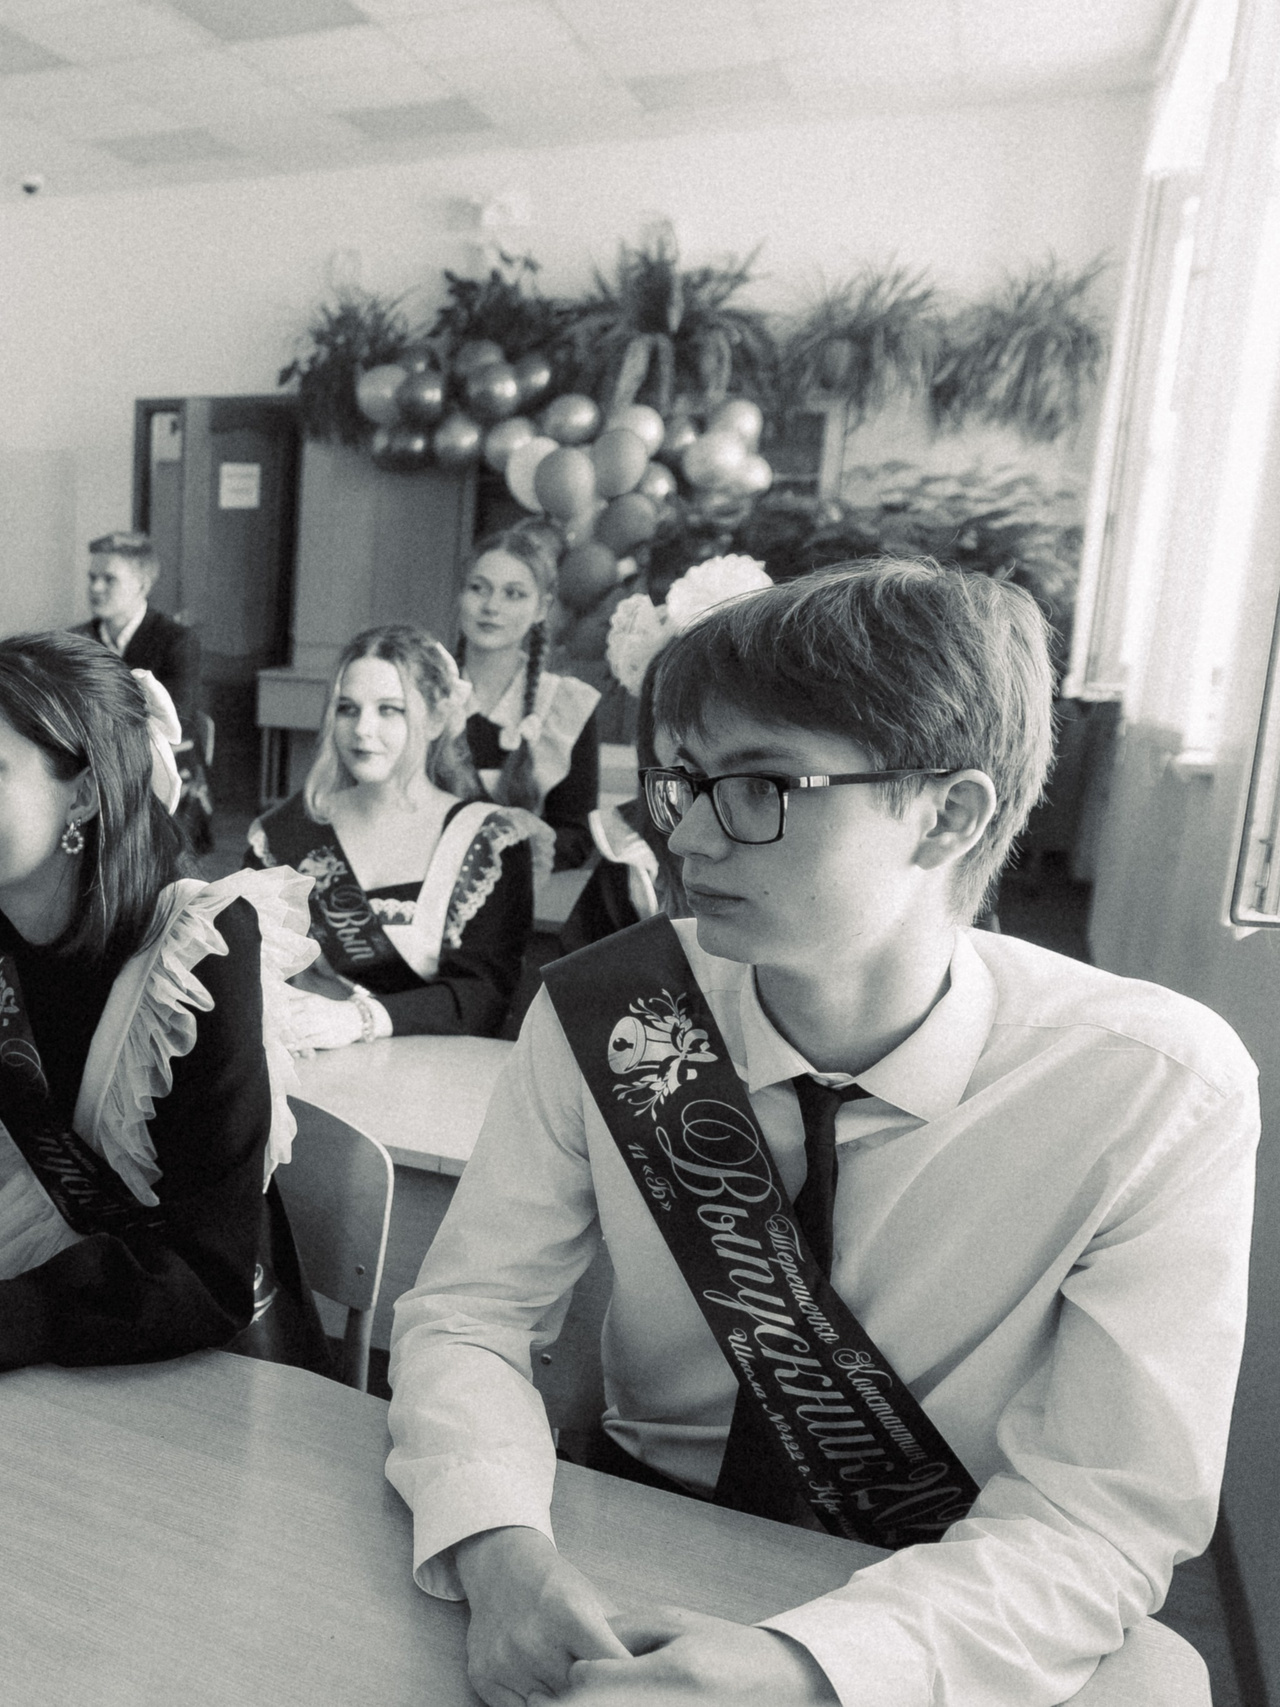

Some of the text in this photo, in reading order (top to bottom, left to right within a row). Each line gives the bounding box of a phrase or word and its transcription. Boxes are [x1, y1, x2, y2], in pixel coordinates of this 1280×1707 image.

[628, 1143, 677, 1212] 11 «Б»
[656, 1098, 895, 1496] Выпускник
[727, 1327, 768, 1399] Школа
[761, 1403, 806, 1462] №422
[831, 1347, 928, 1463] Константин
